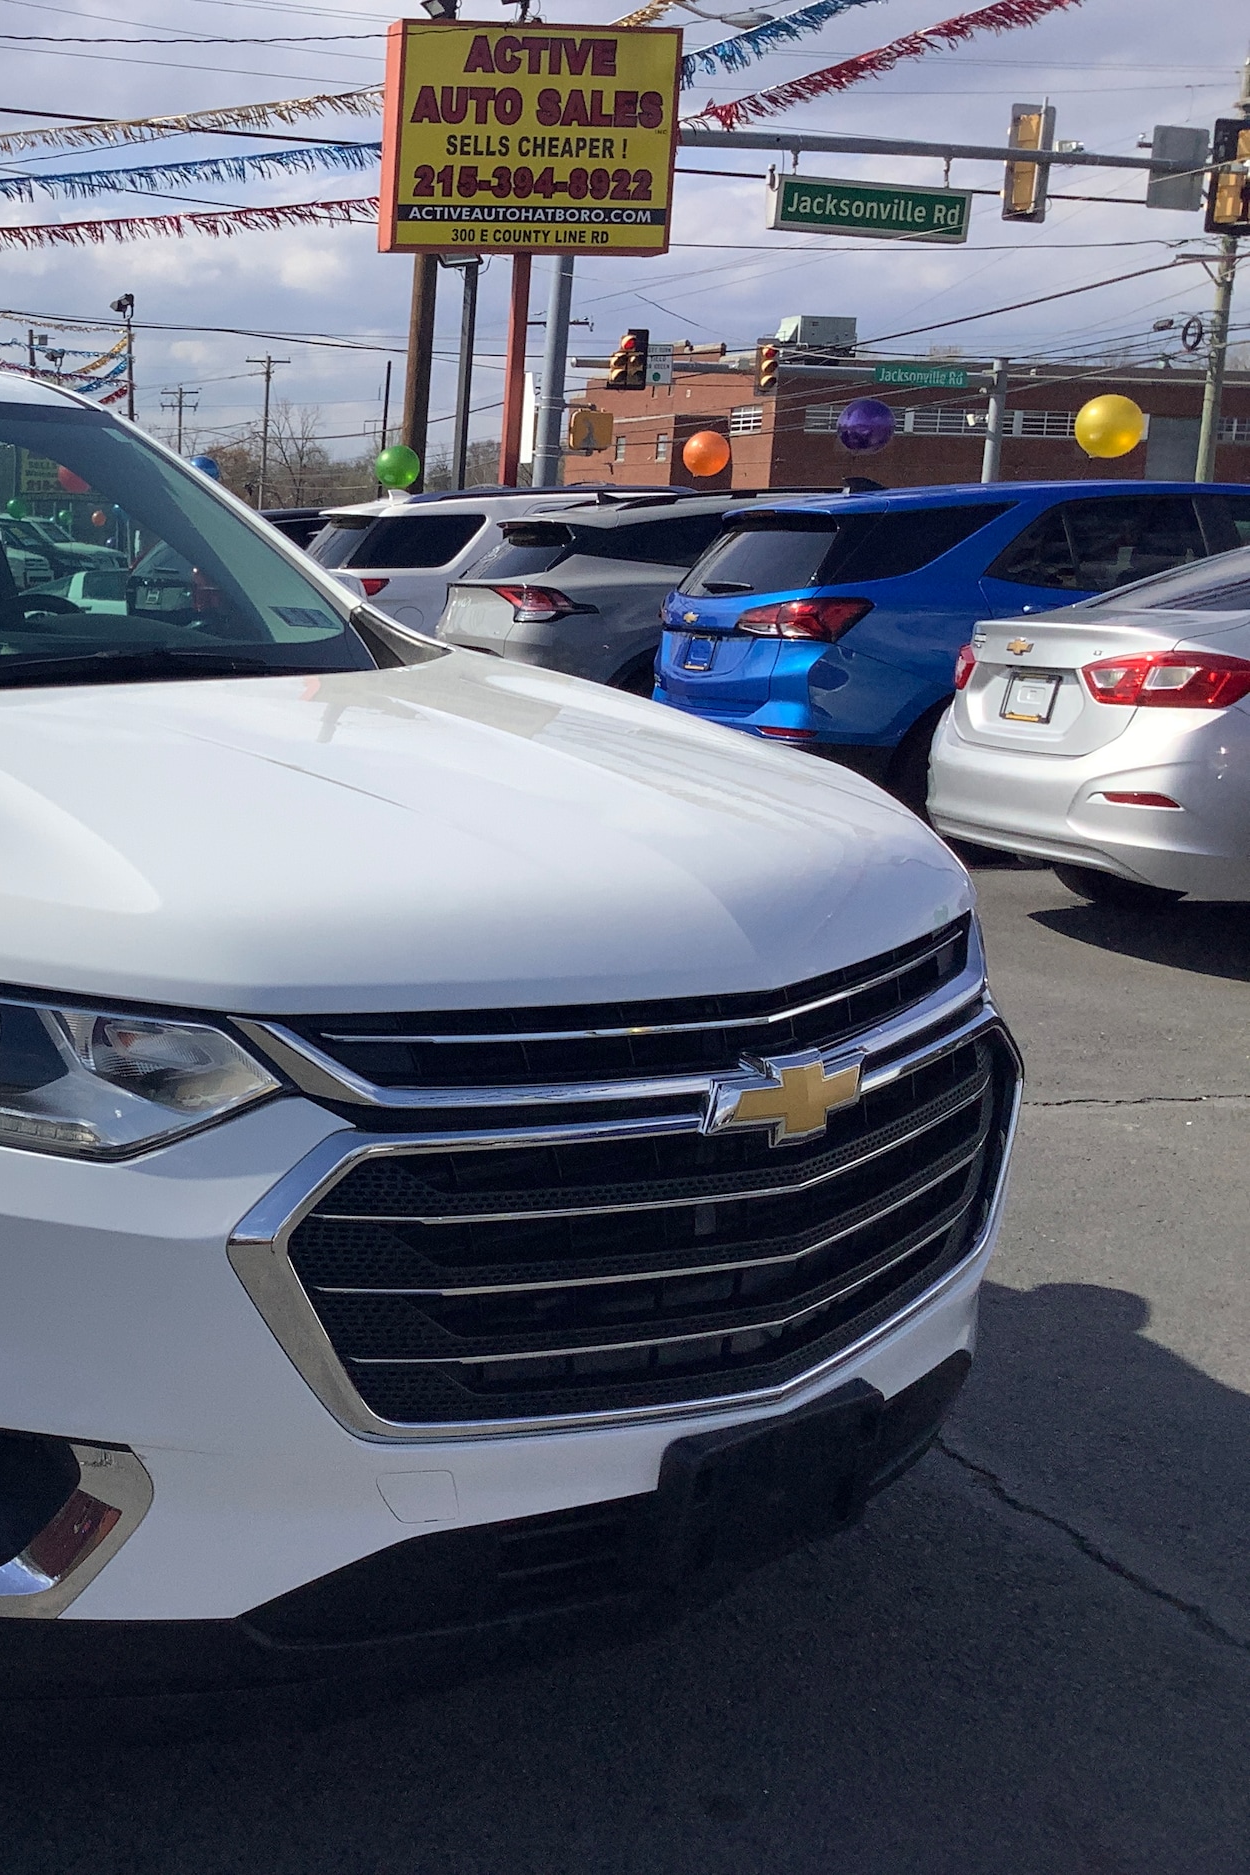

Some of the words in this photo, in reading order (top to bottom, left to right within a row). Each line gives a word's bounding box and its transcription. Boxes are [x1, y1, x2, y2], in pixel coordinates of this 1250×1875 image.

[463, 35, 618, 77] ACTIVE
[410, 86, 523, 126] AUTO
[536, 88, 663, 129] SALES
[446, 134, 510, 157] SELLS
[518, 136, 615, 159] CHEAPER
[412, 164, 653, 201] 215-394-8922
[409, 206, 652, 224] ACTIVEAUTOHATBORO.COM
[787, 192, 927, 223] Jacksonville
[933, 204, 961, 226] Rd
[451, 228, 475, 242] 300
[480, 229, 488, 242] E
[493, 229, 551, 243] COUNTY
[555, 230, 586, 244] LINE
[590, 231, 609, 244] RD
[879, 367, 946, 385] Jacksonville
[948, 371, 964, 385] Rd
